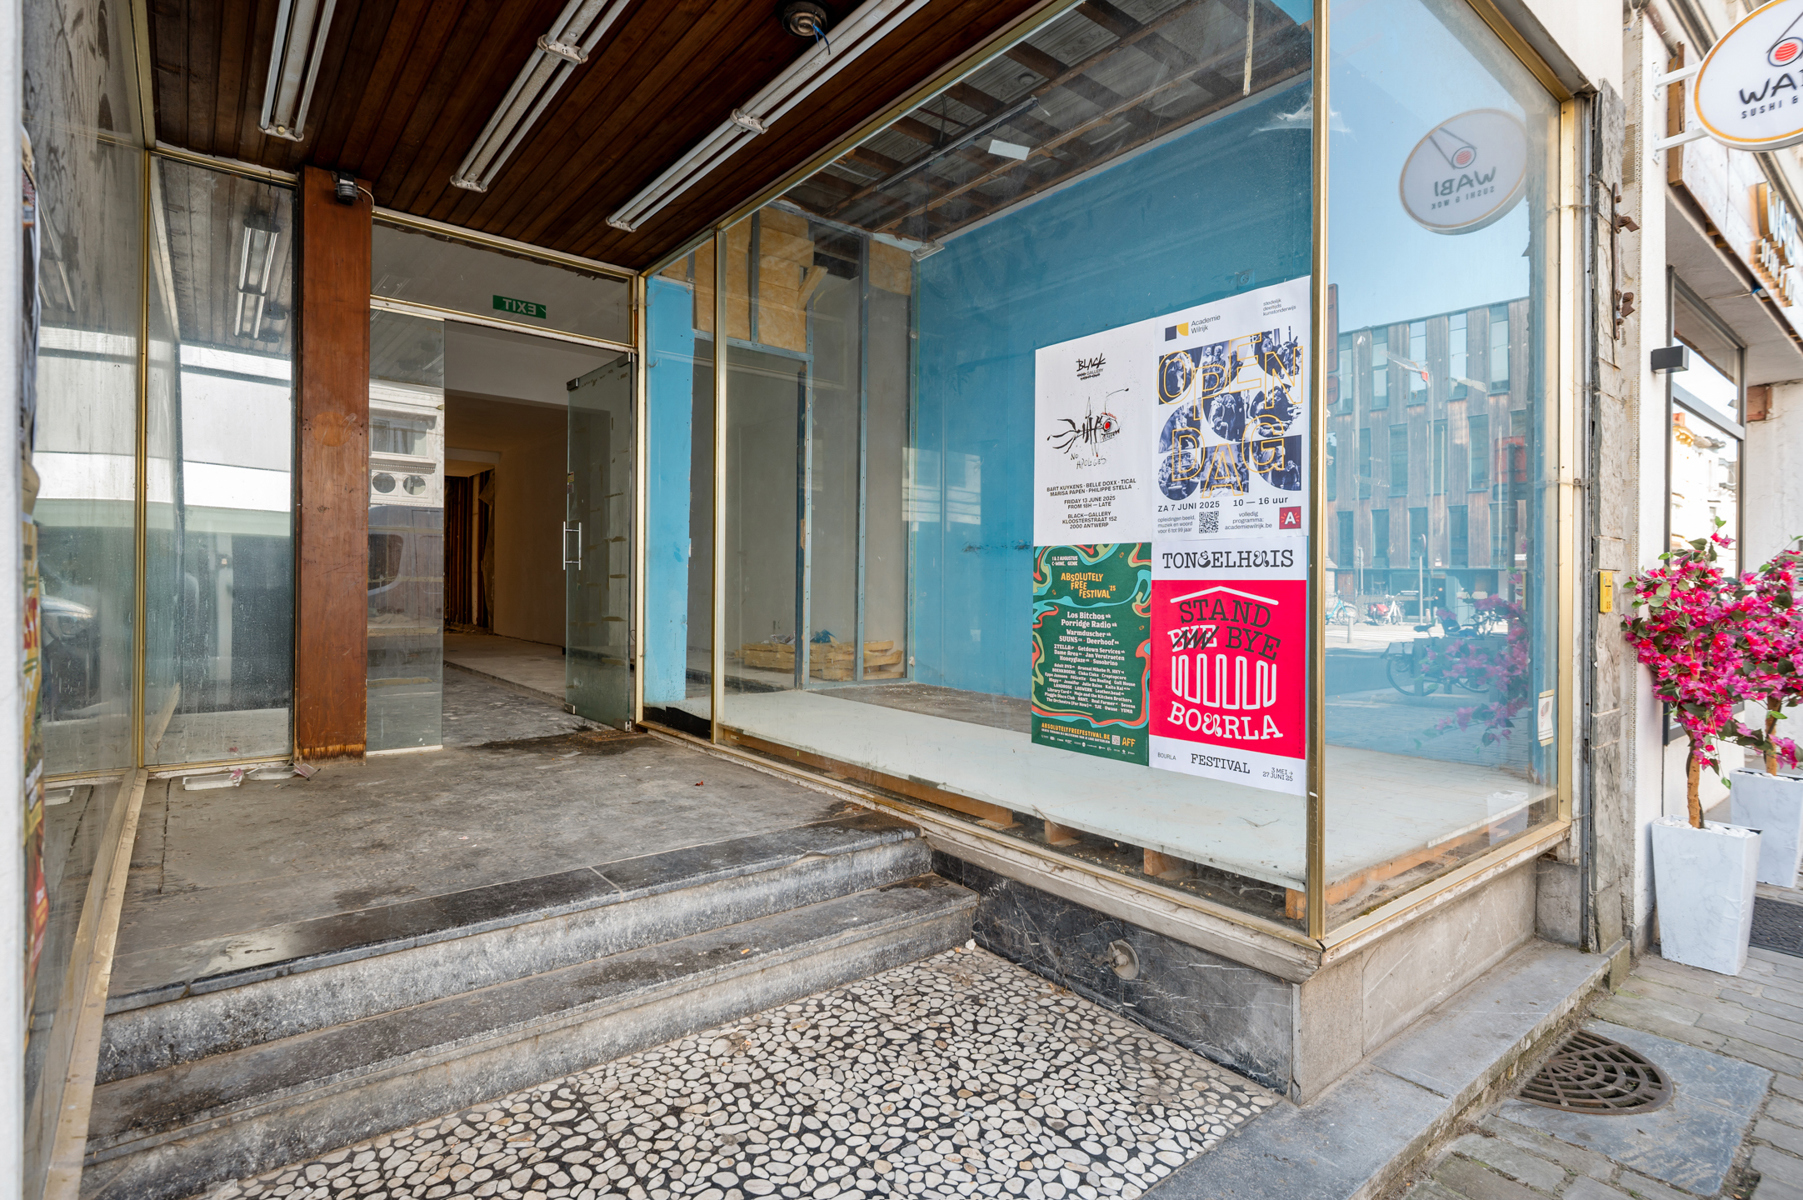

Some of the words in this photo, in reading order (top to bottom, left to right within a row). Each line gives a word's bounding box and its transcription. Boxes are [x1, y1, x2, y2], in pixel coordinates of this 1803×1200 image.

[1739, 69, 1803, 105] WA
[1741, 100, 1782, 119] SUSHI
[1191, 315, 1221, 327] Academie
[1191, 325, 1208, 334] Wilrijk
[1157, 332, 1303, 421] OPEN
[1171, 414, 1284, 499] DAG
[1200, 501, 1220, 509] 2025
[1259, 497, 1269, 505] 16
[1284, 512, 1296, 525] A
[1061, 572, 1104, 582] ABSOLUTELY
[1071, 581, 1087, 590] FREE
[1079, 589, 1110, 598] FESTIVAL
[1079, 612, 1105, 620] Bitchos
[1180, 599, 1271, 628] STAND
[1061, 619, 1090, 629] Porridge
[1066, 629, 1106, 637] Warmduscher
[1087, 638, 1114, 646] Deerhoof
[1225, 626, 1281, 661] BYE
[1041, 723, 1110, 740] ABSOLUTELYFREEFESTIVAL.BE
[1122, 737, 1136, 747] AFF
[1157, 752, 1176, 760] BOURLA
[1191, 753, 1250, 774] FESTIVAL
